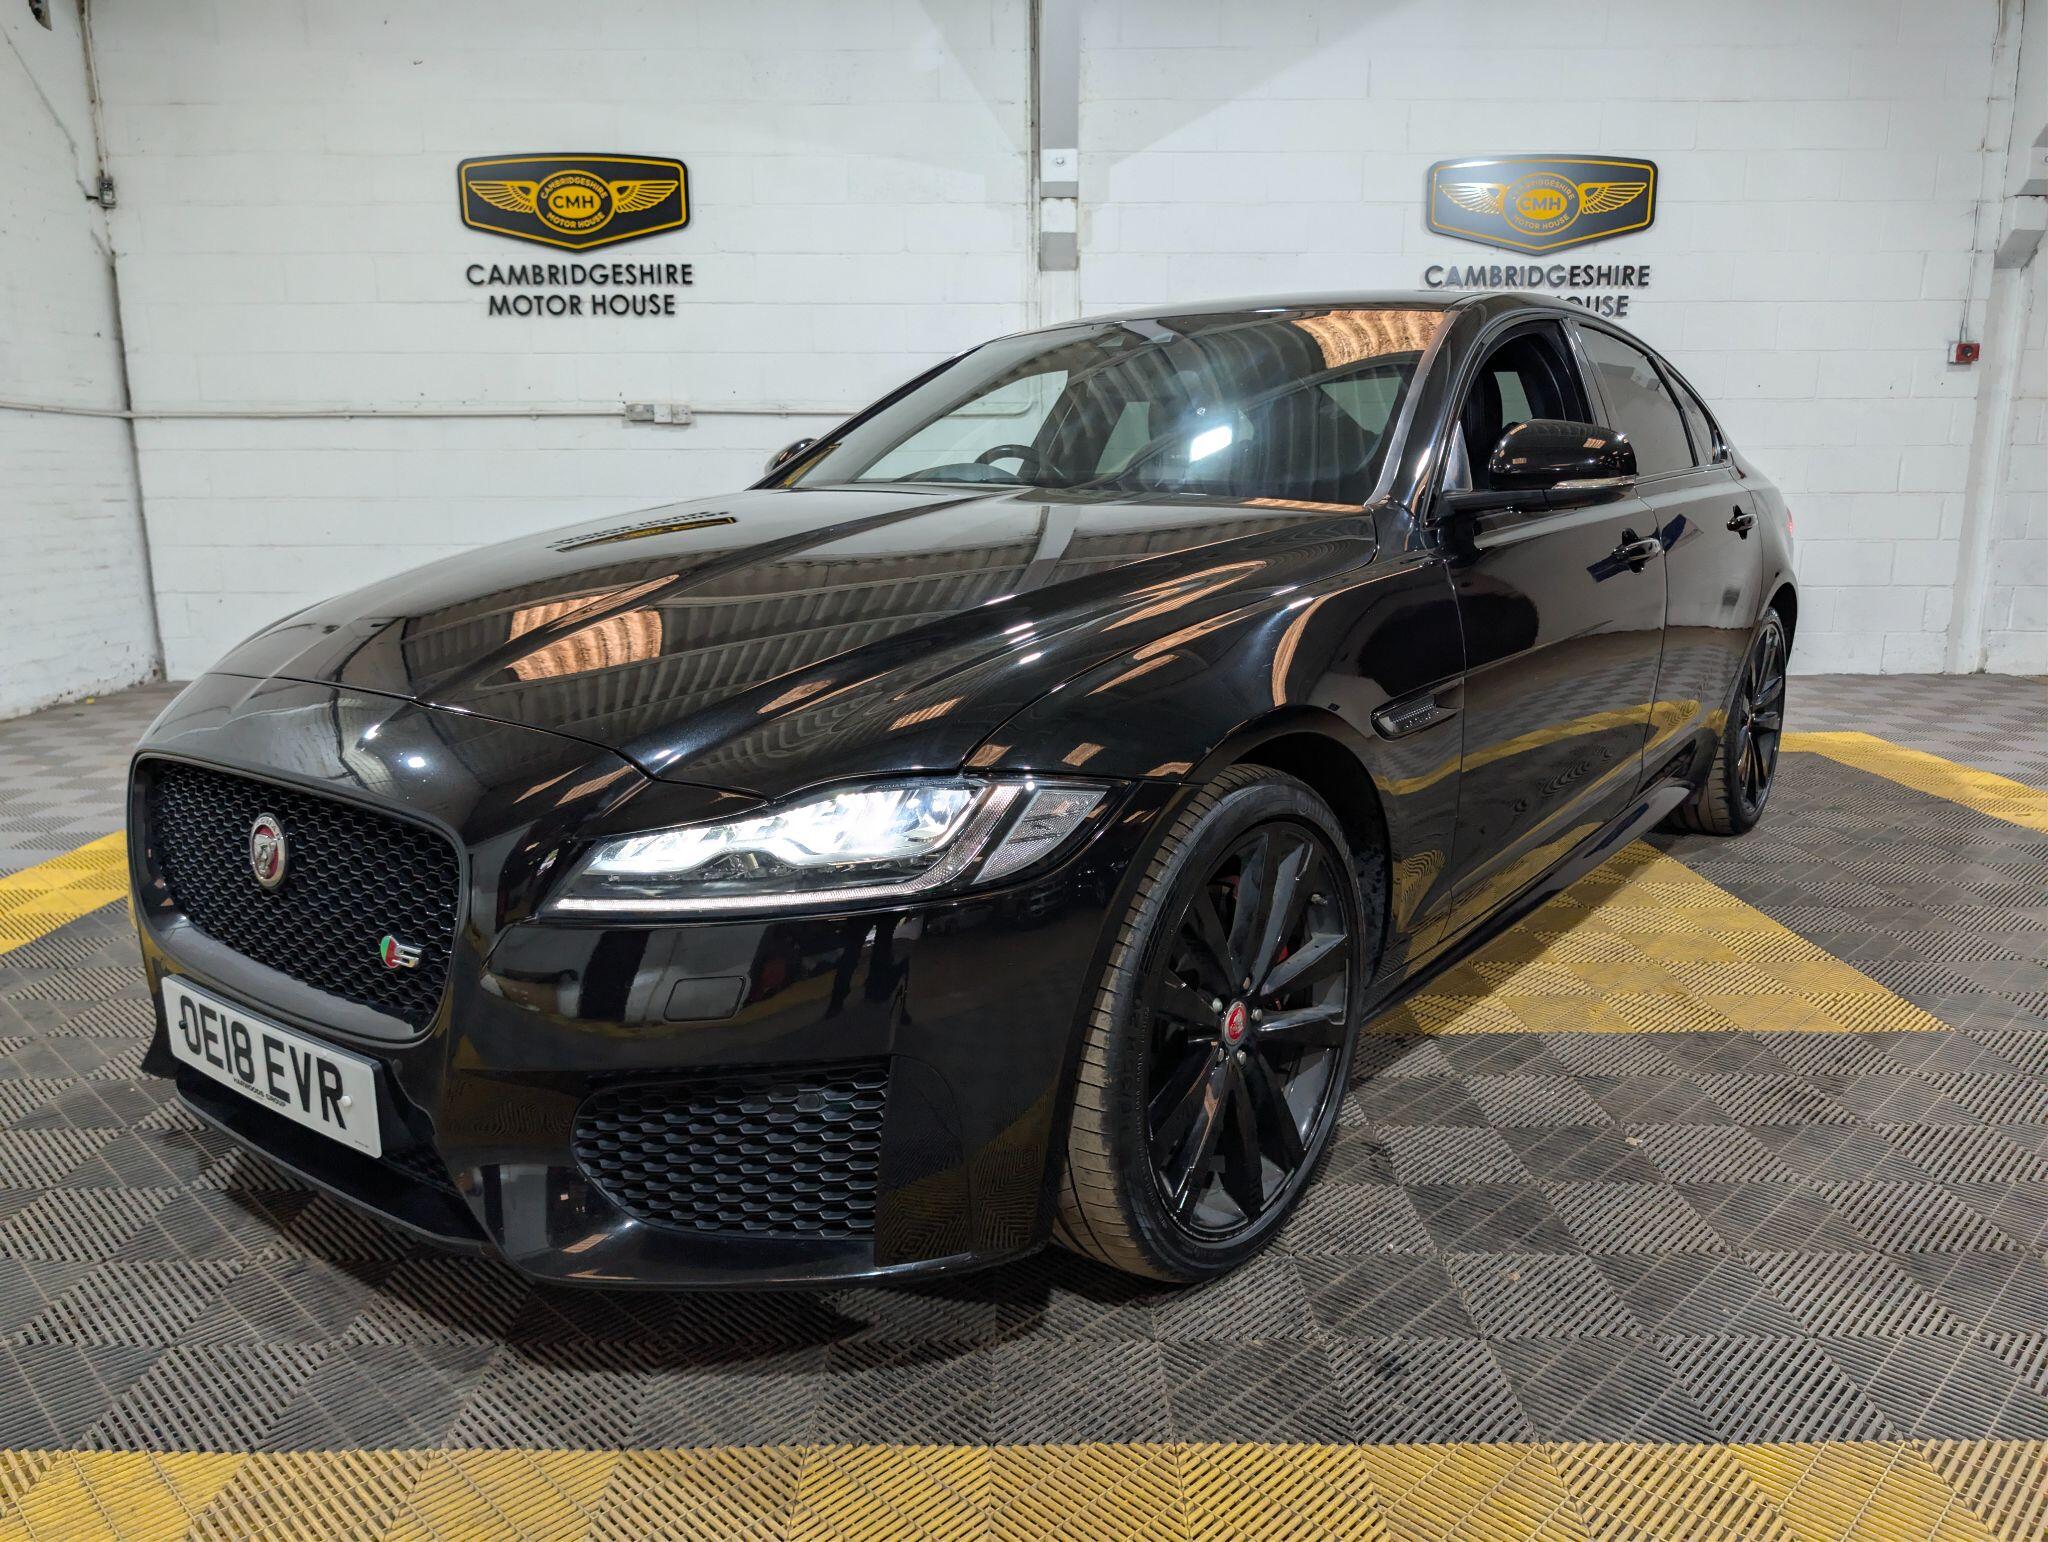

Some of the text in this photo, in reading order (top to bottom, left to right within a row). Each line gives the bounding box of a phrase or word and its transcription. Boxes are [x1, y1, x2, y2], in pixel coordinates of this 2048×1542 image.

[540, 176, 609, 199] CAMBRIDGESHIRE
[553, 195, 595, 209] CMH
[1520, 197, 1562, 211] CMH
[546, 211, 606, 229] MOTOR HOUSE
[1542, 213, 1570, 230] HOUSE
[466, 263, 694, 286] CAMBRIDGESHIRE
[1424, 264, 1650, 288] CAMBRIDGESHIRE
[489, 294, 676, 316] MOTOR HOUSE
[180, 995, 347, 1130] OE18 EVR
